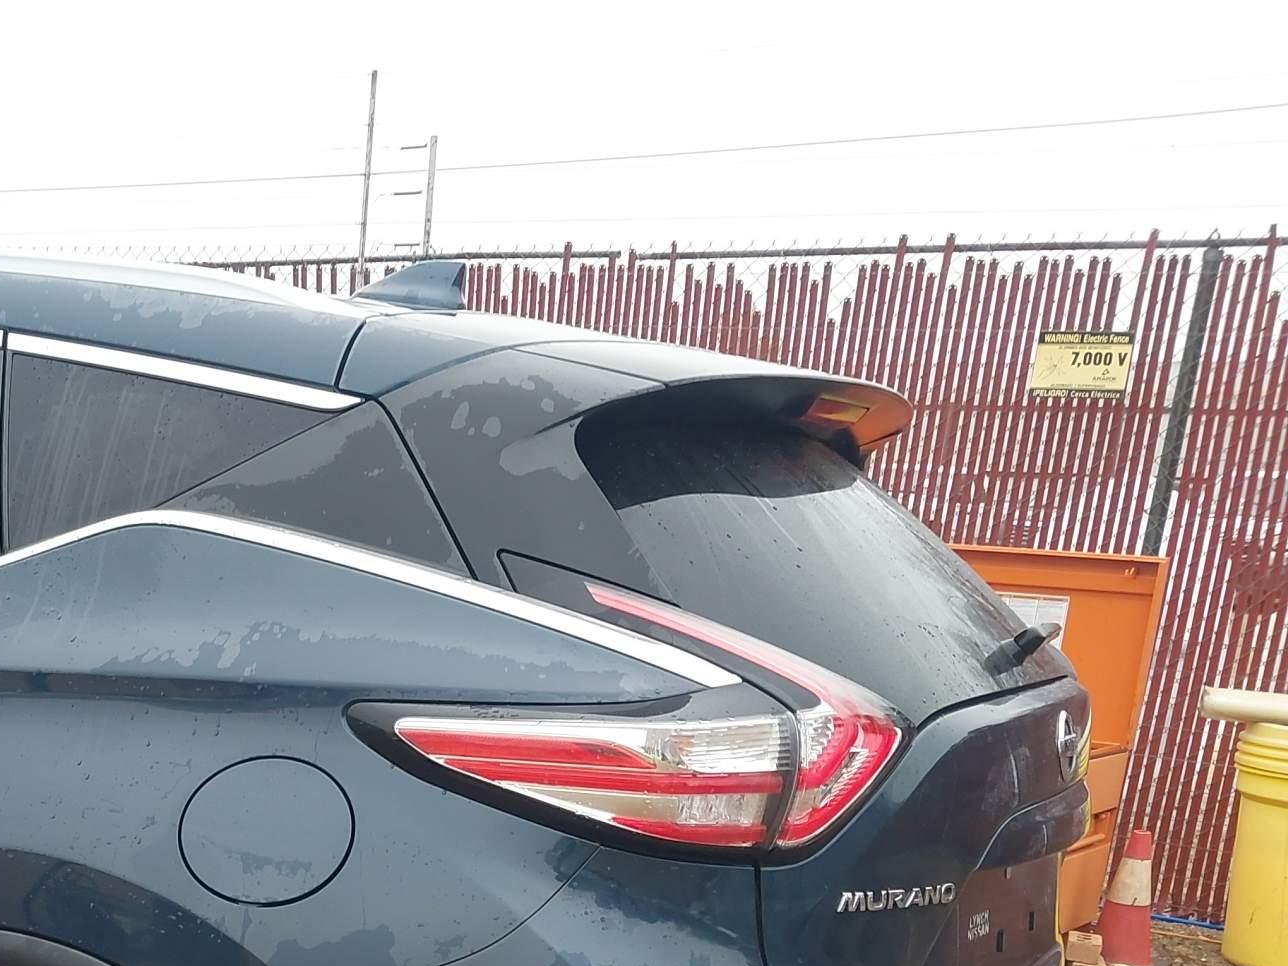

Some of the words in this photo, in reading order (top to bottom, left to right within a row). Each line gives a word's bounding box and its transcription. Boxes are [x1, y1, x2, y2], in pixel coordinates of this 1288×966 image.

[1044, 333, 1081, 344] WARNING!
[1083, 334, 1108, 344] Electric
[1109, 335, 1130, 344] Fence
[1071, 351, 1114, 368] 7,000
[1118, 352, 1128, 367] V
[1070, 390, 1089, 398] Cerca
[837, 882, 956, 913] MURANO
[969, 909, 990, 929] LYNCH
[967, 921, 990, 942] NISSAN
